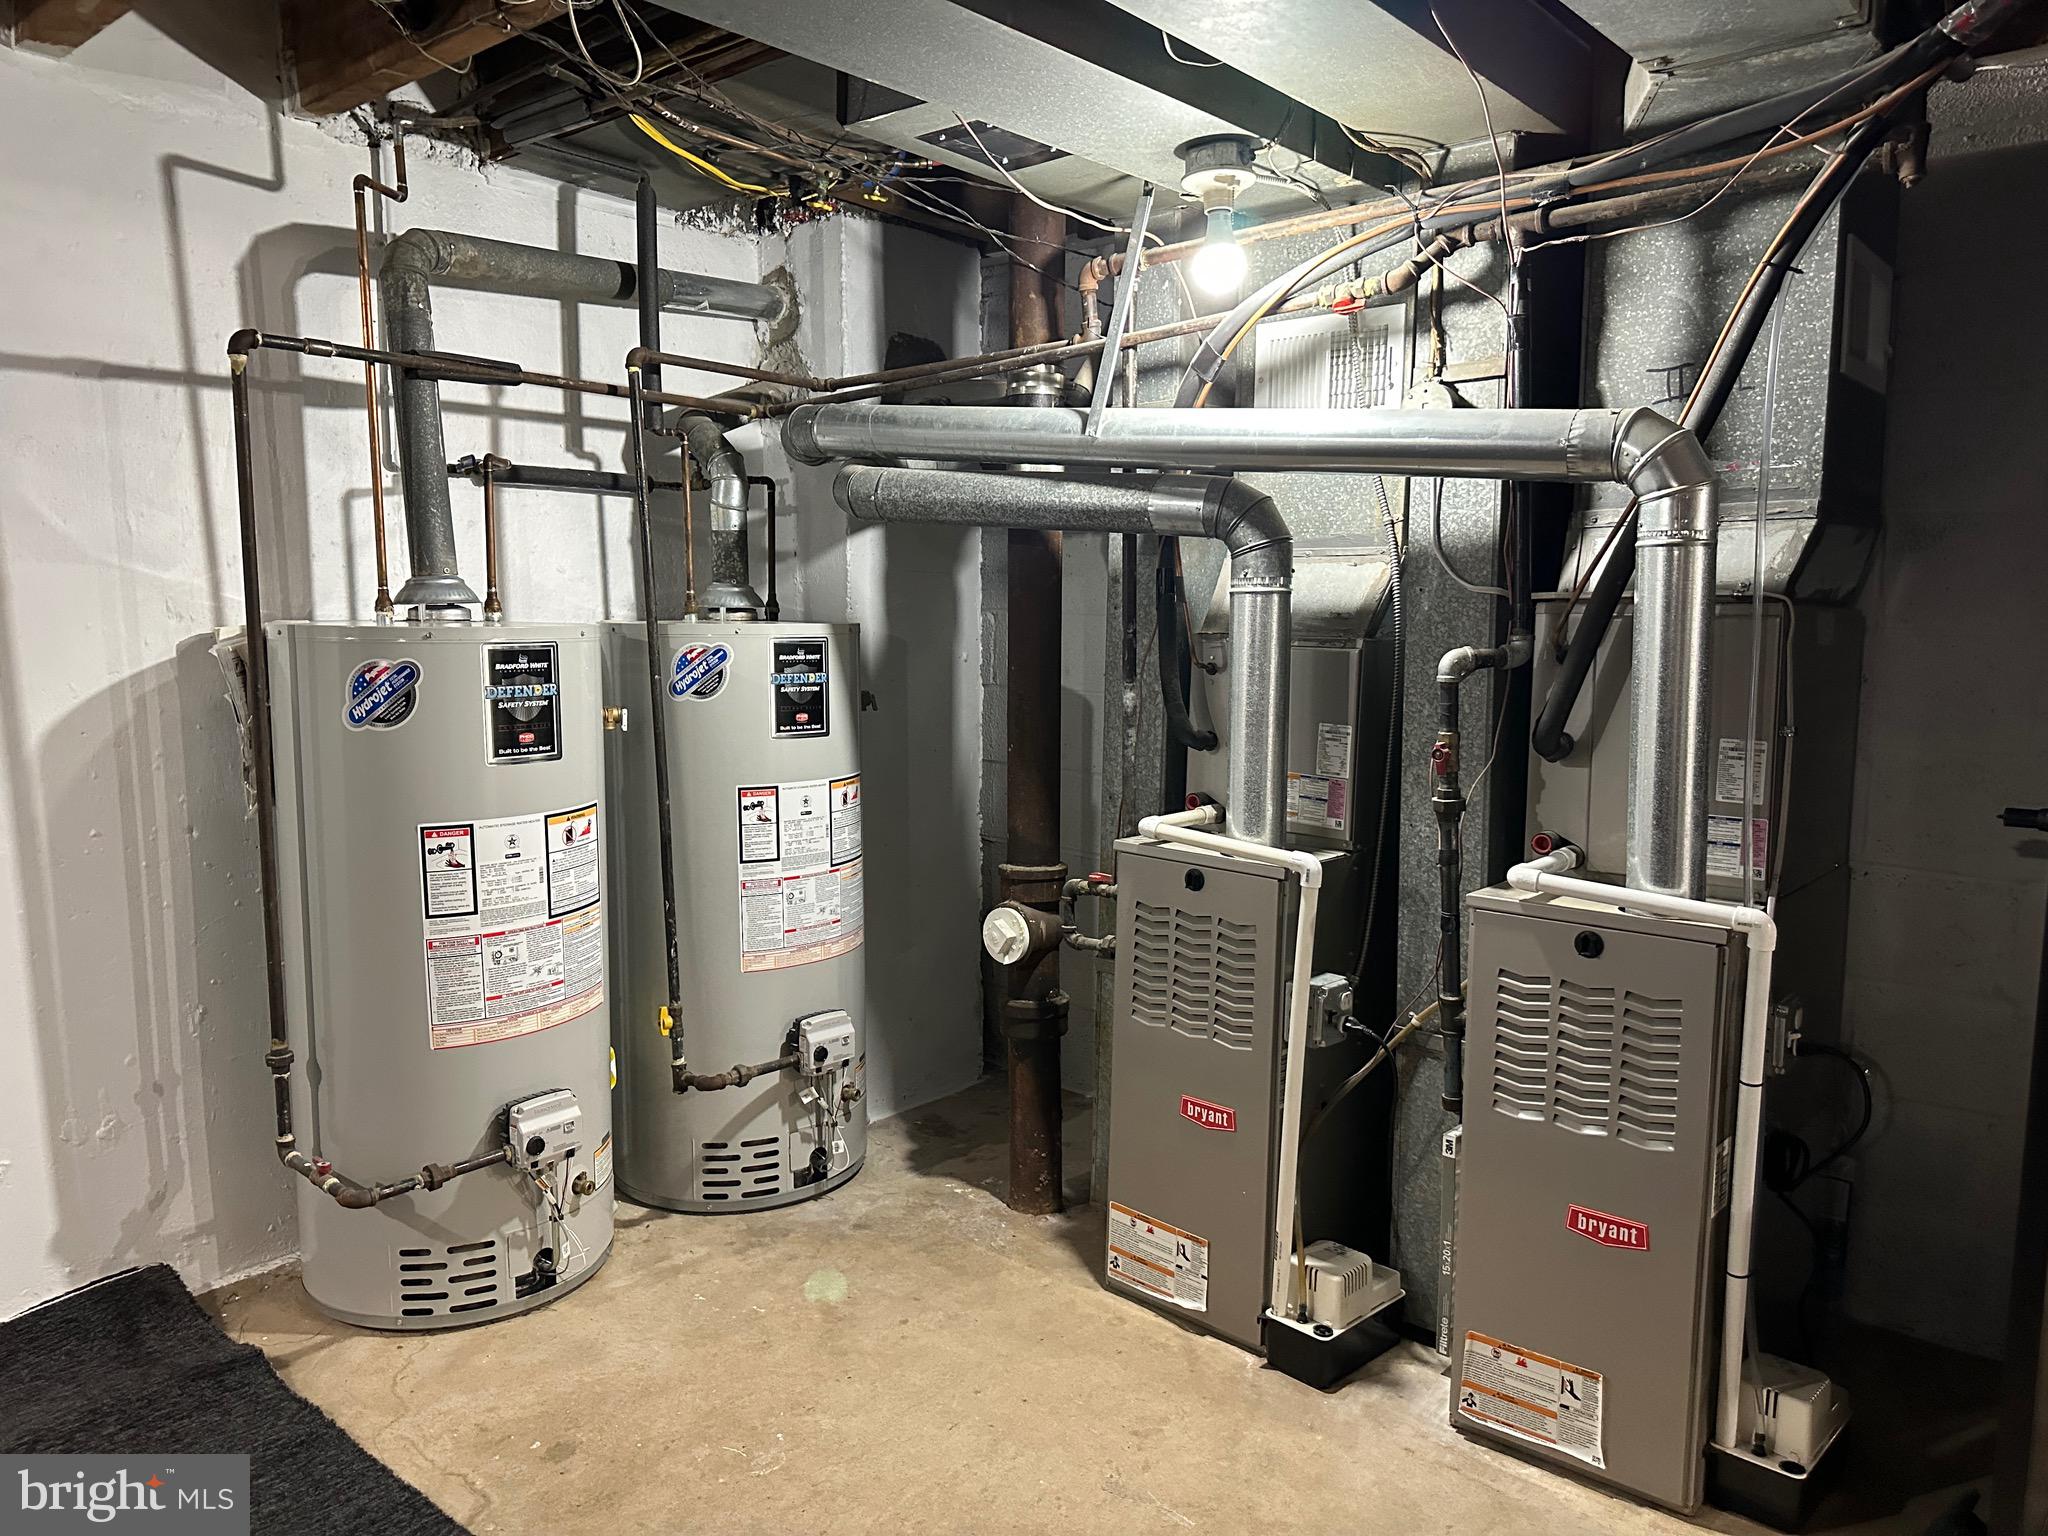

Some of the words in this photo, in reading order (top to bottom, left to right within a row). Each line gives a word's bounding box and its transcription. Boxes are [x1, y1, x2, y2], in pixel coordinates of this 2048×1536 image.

[674, 661, 709, 692] Hydrojet
[771, 673, 828, 685] DEFENDER
[352, 680, 393, 720] Hydrojet
[485, 684, 558, 699] DEFENDER
[498, 701, 523, 709] SAFETY
[1187, 1101, 1228, 1127] bryant
[1445, 1139, 1454, 1156] 3M
[1577, 1212, 1638, 1245] bryant
[1438, 1316, 1449, 1355] Filtrete
